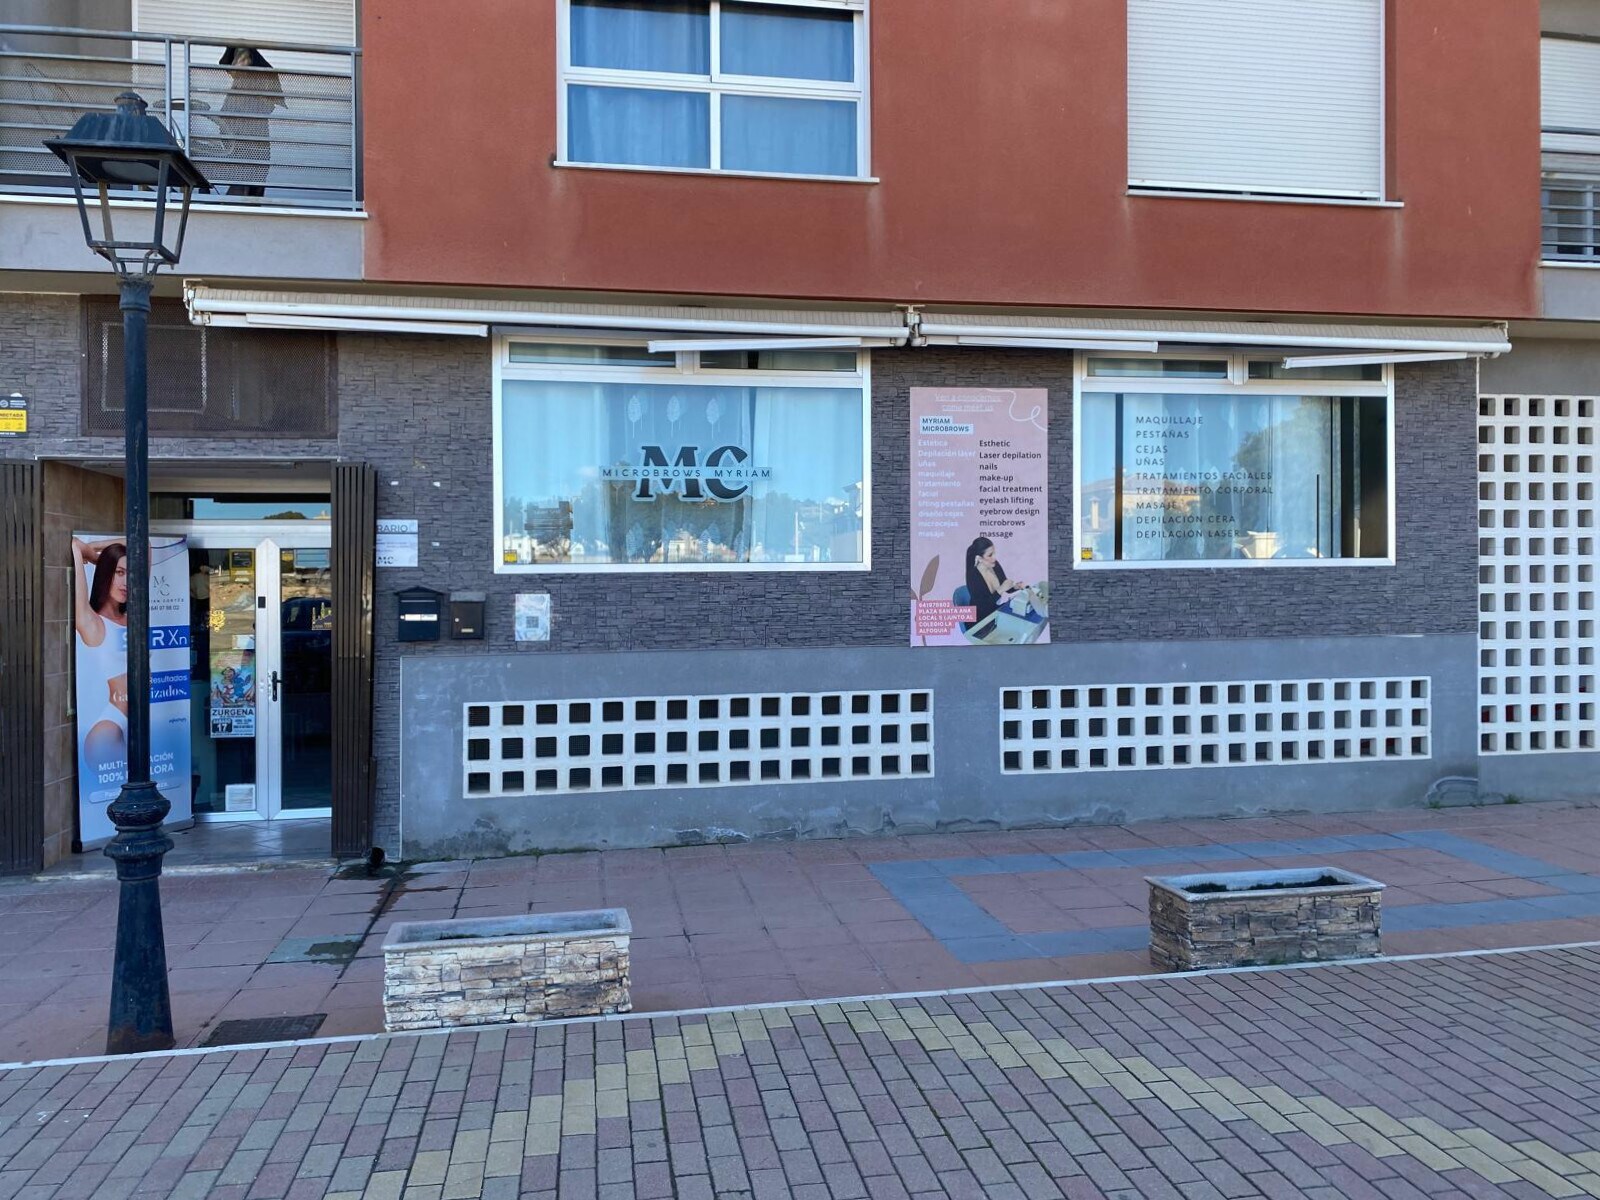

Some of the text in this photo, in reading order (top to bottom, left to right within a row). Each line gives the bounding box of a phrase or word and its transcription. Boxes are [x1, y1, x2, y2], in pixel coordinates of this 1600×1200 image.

[1136, 416, 1204, 425] MAQUILLAJE
[1136, 429, 1190, 438] PESTAÑAS
[979, 440, 1010, 448] Esthetic
[1136, 445, 1168, 454] CEJAS
[1002, 452, 1042, 460] depilation
[1136, 456, 1164, 466] UÑAS
[602, 469, 770, 478] MICROBROWS MYRIAM
[636, 446, 749, 499] MC
[1136, 472, 1272, 480] TRATAMIENTOS FACIALES
[979, 474, 1014, 483] make-up
[1136, 486, 1274, 495] TRATAMIENTO CORPORAL
[979, 497, 1034, 505] eyelash lifting
[1136, 502, 1176, 510] MASAJE
[979, 508, 1040, 516] eyebrow design
[1136, 514, 1236, 524] DEPILACIÓN CERA
[979, 531, 1014, 539] massage
[1136, 530, 1202, 538] DEPILACIÓN
[217, 724, 228, 732] 17
[98, 771, 124, 784] 100%
